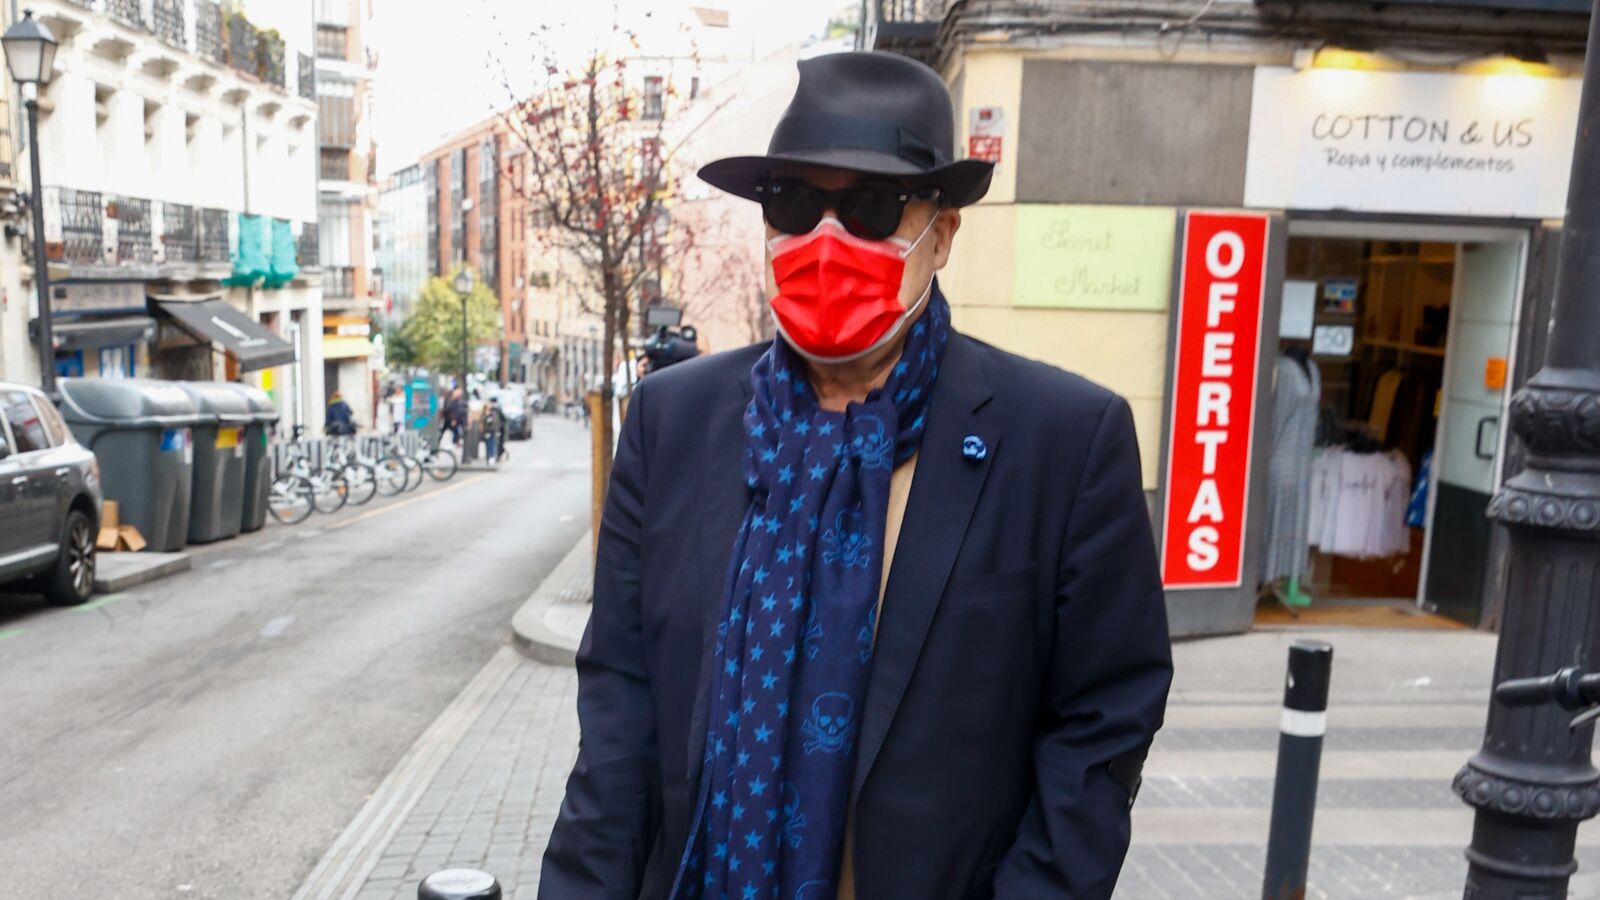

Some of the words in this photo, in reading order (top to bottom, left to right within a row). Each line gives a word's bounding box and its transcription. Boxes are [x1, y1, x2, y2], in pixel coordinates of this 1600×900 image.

[1311, 114, 1449, 143] COTTON
[1460, 121, 1484, 144] &
[1493, 119, 1533, 148] US
[1325, 149, 1370, 170] Ropa
[1376, 155, 1387, 171] y
[1391, 153, 1514, 173] complementos
[1054, 265, 1140, 294] Market
[1186, 230, 1246, 571] OFERTAS
